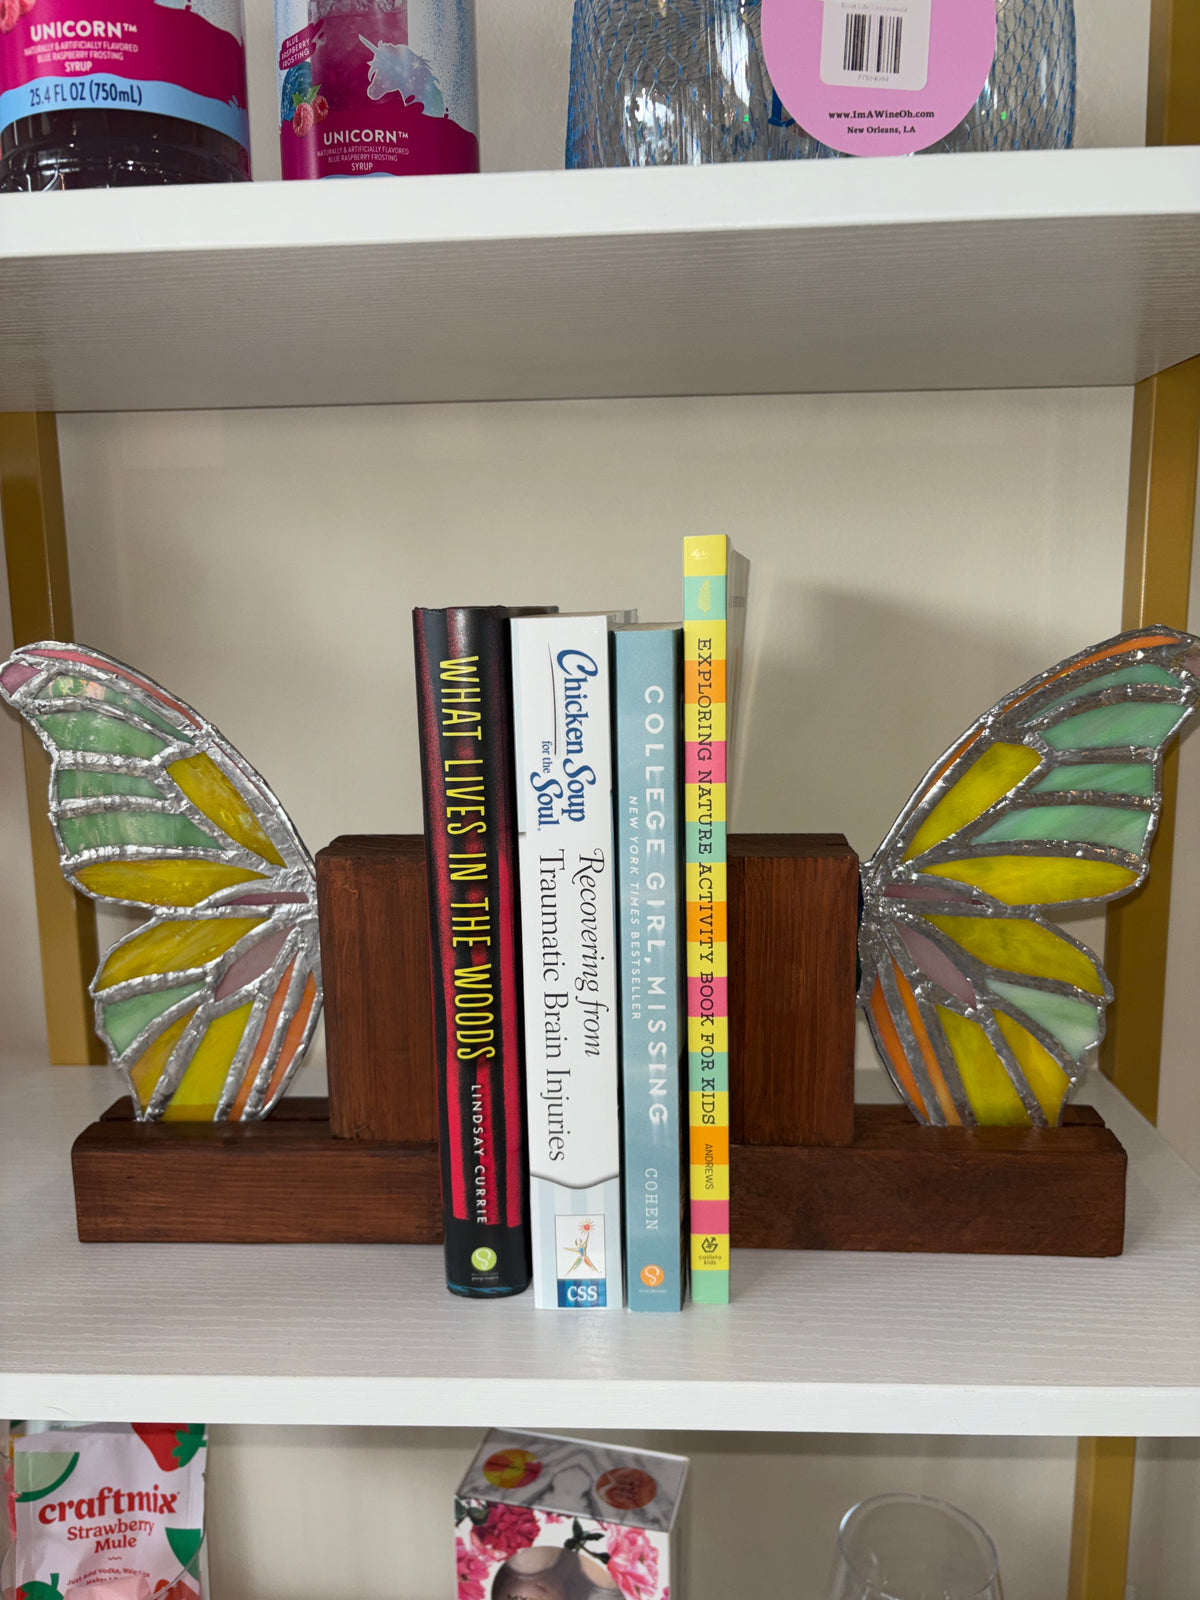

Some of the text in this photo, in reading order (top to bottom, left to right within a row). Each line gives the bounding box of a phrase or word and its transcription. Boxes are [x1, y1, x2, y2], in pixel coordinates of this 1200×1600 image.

[52, 51, 88, 61] RASPBERRY
[89, 51, 124, 61] FROSTING
[103, 41, 139, 53] FLAVORED
[65, 61, 93, 73] SYRUP
[30, 79, 143, 107] 25.4 FL OZ (750mL)
[828, 109, 935, 119] www.ImAWineOh.com
[847, 125, 916, 135] New Orleans, LA
[317, 147, 343, 157] NATURALLY
[348, 145, 381, 154] ARTIFICIALLY
[382, 145, 409, 155] FLAVORED
[328, 153, 398, 163] BLUE RASPBERRY FROSTING
[351, 162, 374, 171] SYRUP
[556, 649, 599, 823] Chicken Soup
[541, 740, 553, 774] for the
[439, 655, 496, 1061] WHAT LIVES IN THE WOODS
[697, 638, 716, 1126] EXPLORING NATURE ACTIVITY BOOK FOR KIDS
[628, 795, 641, 1020] NEW YORK TIMES BESTSELLER
[643, 685, 669, 1125] COLLEGE GIRL, MISSING
[571, 847, 610, 1058] Recovering from
[539, 848, 571, 1162] Traumatic Brain Injuries
[471, 1084, 488, 1224] LINDSAY CURRIE
[704, 1142, 714, 1190] ANDREWS
[644, 1167, 659, 1231] COHEN
[566, 1285, 598, 1302] CSS
[38, 1484, 178, 1525] craftmix
[67, 1518, 155, 1542] Strawberry
[94, 1534, 138, 1554] Mule
